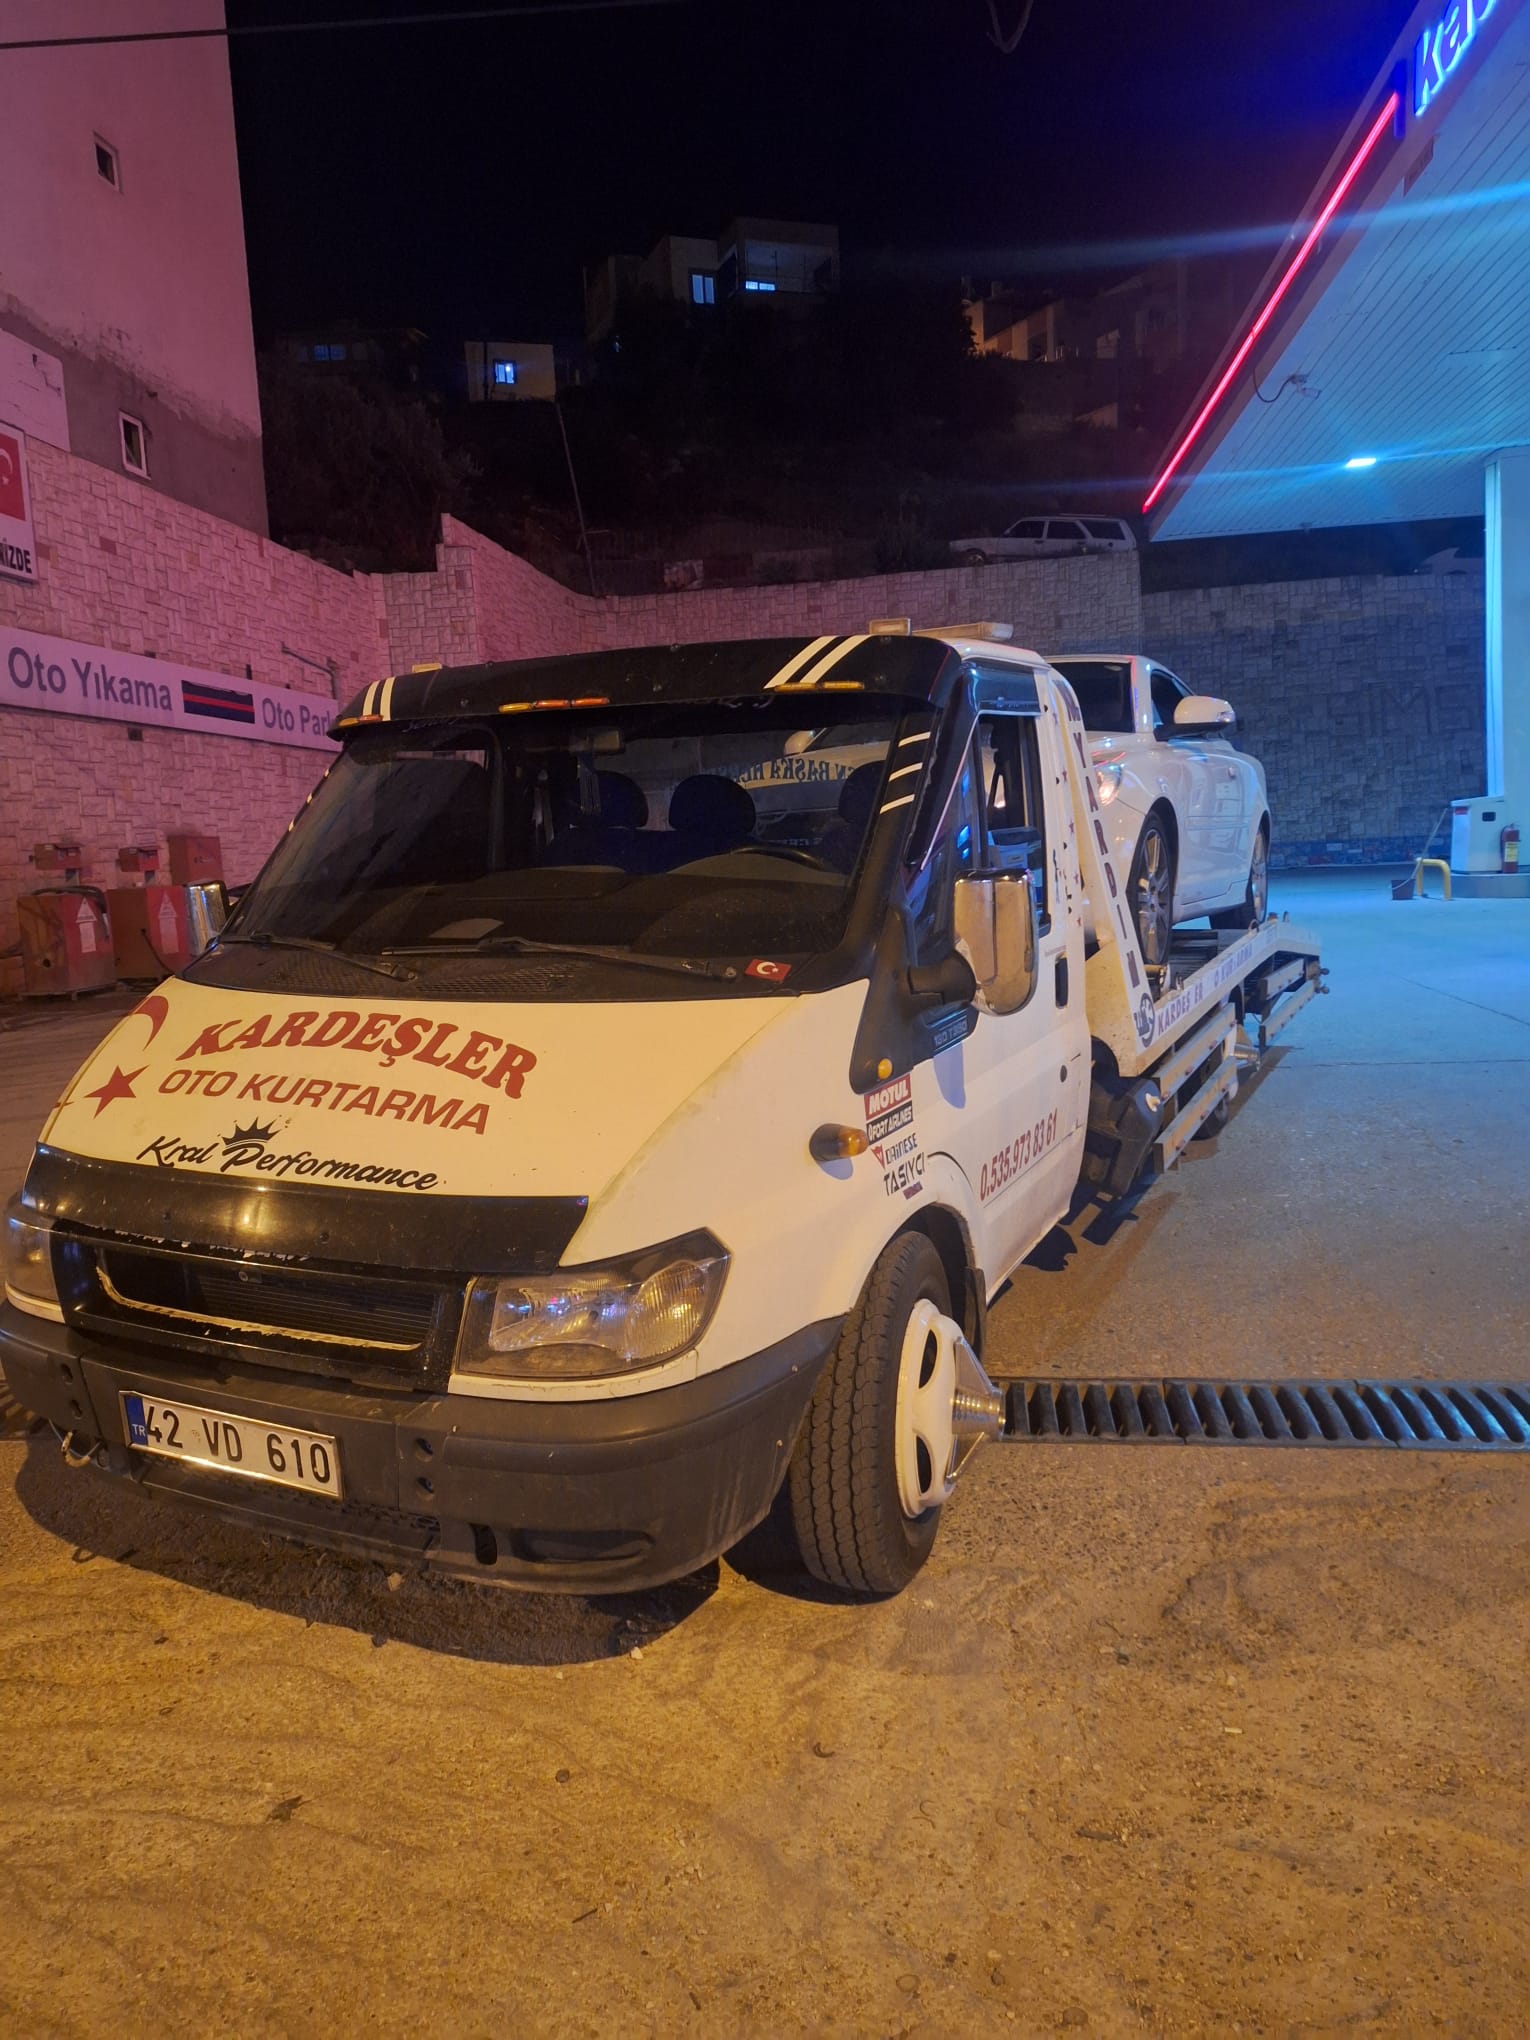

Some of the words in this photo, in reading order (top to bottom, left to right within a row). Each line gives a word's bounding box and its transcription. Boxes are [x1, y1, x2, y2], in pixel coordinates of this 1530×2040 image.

[8, 647, 65, 693] Oto
[72, 658, 172, 711] Yıkama
[262, 697, 294, 731] Oto
[176, 1011, 538, 1099] KARDEŞLER
[158, 1069, 238, 1097] OTO
[237, 1073, 491, 1135] KURTARMA
[869, 1080, 908, 1115] MOTUL
[1033, 1119, 1045, 1158] 83
[1047, 1107, 1058, 1146] 61
[137, 1136, 219, 1168] Kral
[220, 1142, 439, 1191] Performance
[132, 1424, 146, 1437] TR
[147, 1406, 183, 1449] 42
[202, 1418, 243, 1462] VD
[267, 1433, 330, 1484] 610
